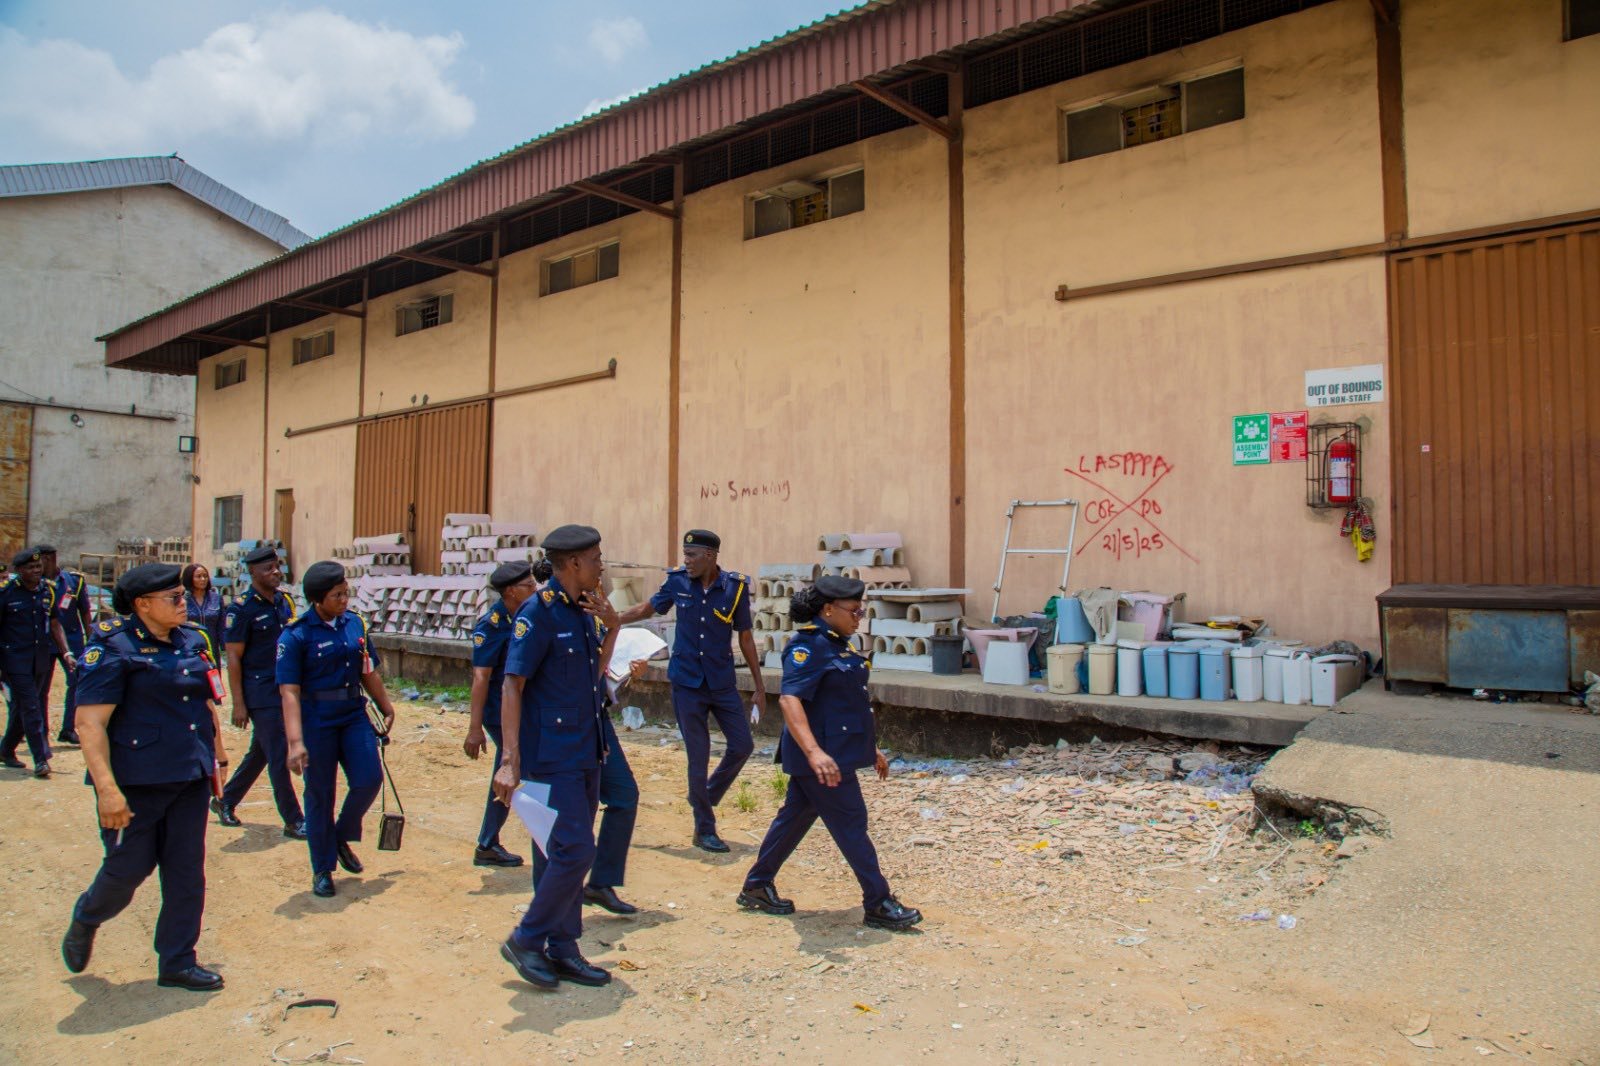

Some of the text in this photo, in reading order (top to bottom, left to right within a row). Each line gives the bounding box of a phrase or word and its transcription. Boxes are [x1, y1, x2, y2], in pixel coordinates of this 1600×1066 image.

[1307, 380, 1382, 396] OUT OF BOUNDS
[1317, 393, 1372, 405] TO NON-STAFF
[1236, 442, 1268, 452] ASSEMBLY
[1243, 450, 1261, 458] POINT
